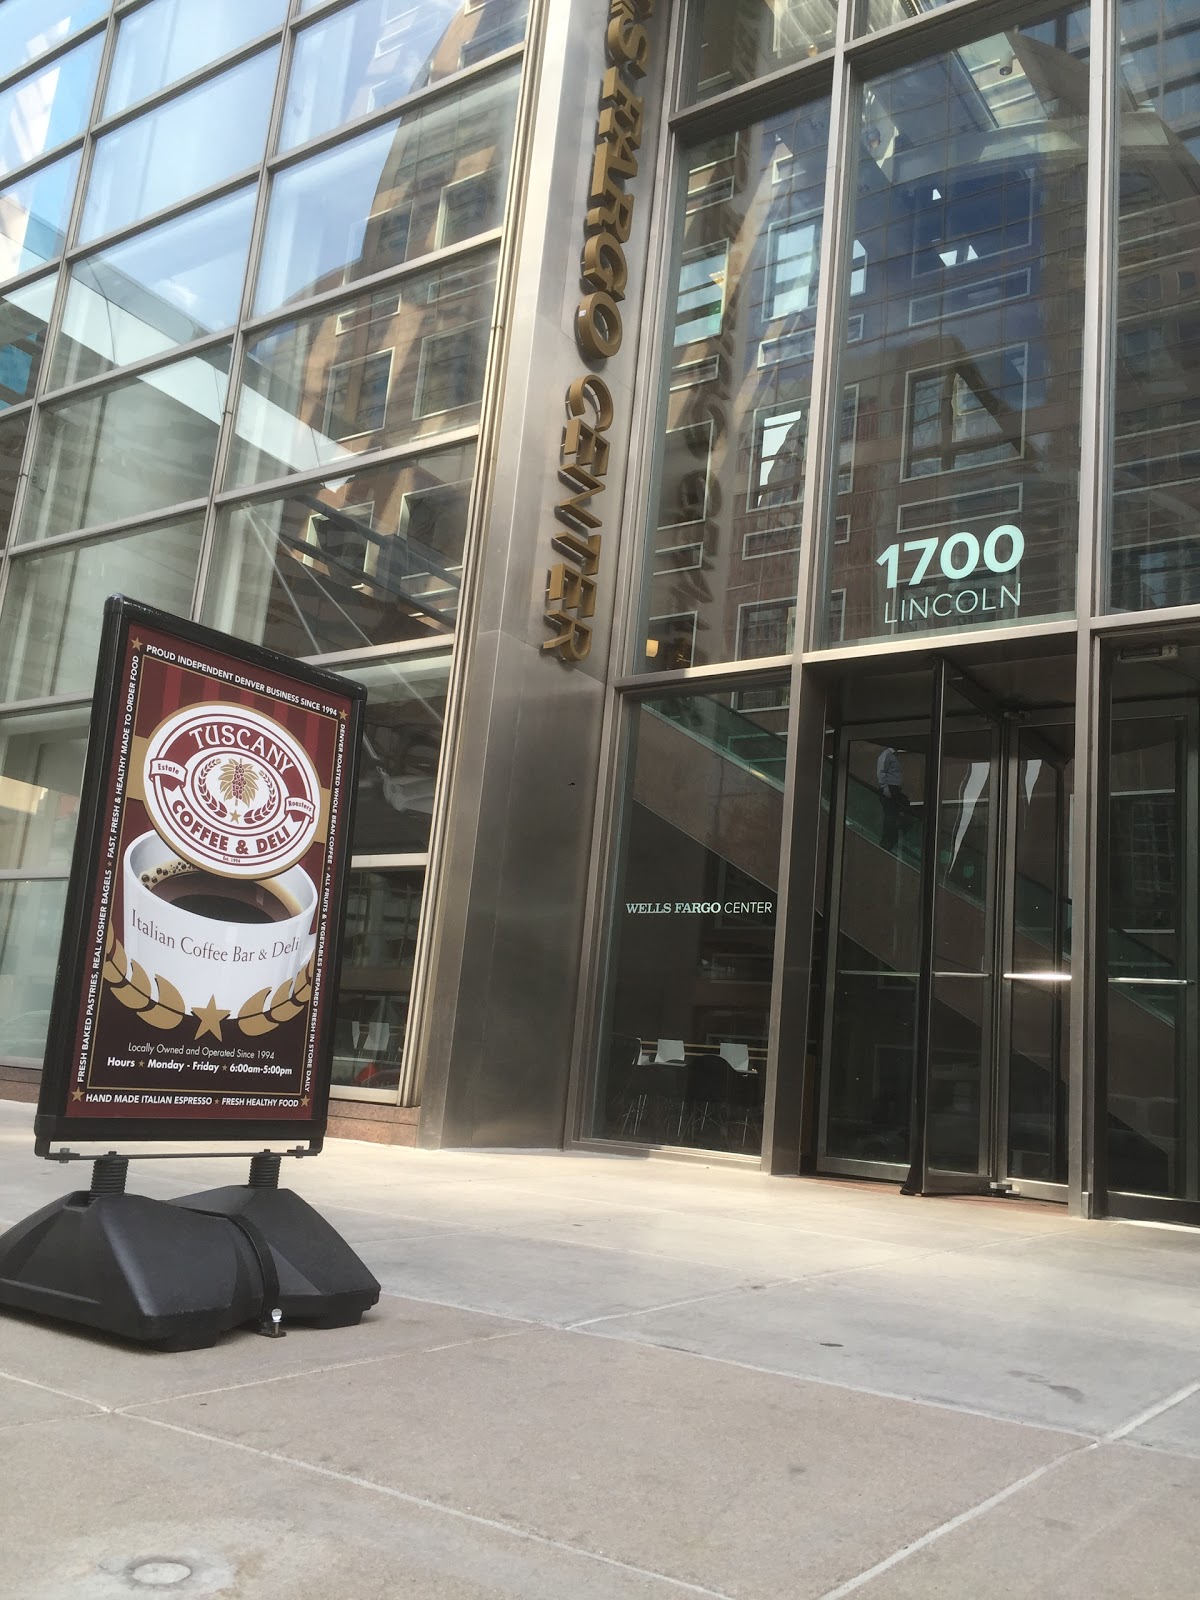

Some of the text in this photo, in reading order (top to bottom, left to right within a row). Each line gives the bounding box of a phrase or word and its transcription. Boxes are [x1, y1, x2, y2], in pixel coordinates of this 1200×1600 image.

[576, 66, 645, 360] FARGO
[542, 374, 614, 663] CENTER
[876, 524, 1025, 589] 1700
[884, 583, 1021, 624] LINCOLN
[146, 644, 337, 717] PROUD INDEPENDENT DENVER BUSINESS SINCE 1994
[189, 724, 295, 775] TUSCANY
[338, 723, 346, 753] DENVER
[157, 763, 180, 775] Estate
[334, 754, 343, 787] ROASTED
[288, 800, 312, 812] Roasters
[332, 787, 340, 814] WHOLE
[172, 799, 291, 855] COFFEE & DELI
[327, 837, 335, 864] COFFEE
[77, 655, 139, 1083] FRESH BAKED PASTRIES, REAL KOSHER BAGELS FAST, FRESH & HEALTHY MADE TO ORDER FOOD
[322, 887, 330, 913] FRUITS
[625, 901, 773, 914] WELLS FARGO CENTER
[132, 908, 300, 962] Italian Coffee Bar & Deli
[316, 921, 327, 967] VEGETABLES
[312, 968, 322, 1007] PREPARED
[310, 1008, 318, 1033] FRESH
[128, 1042, 275, 1060] Locally Owned and Operated Since 1994
[309, 1033, 316, 1043] IN
[107, 1056, 136, 1067] Hours
[147, 1058, 185, 1072] Monday
[192, 1061, 220, 1074] Friday
[229, 1063, 292, 1077] 6:00am-5:00pm
[306, 1044, 314, 1069] STORE
[304, 1070, 312, 1093] DAILY
[85, 1093, 299, 1107] HAND MADE ITALIAN ESPRESSO FRESH HEALTHY FOOD
